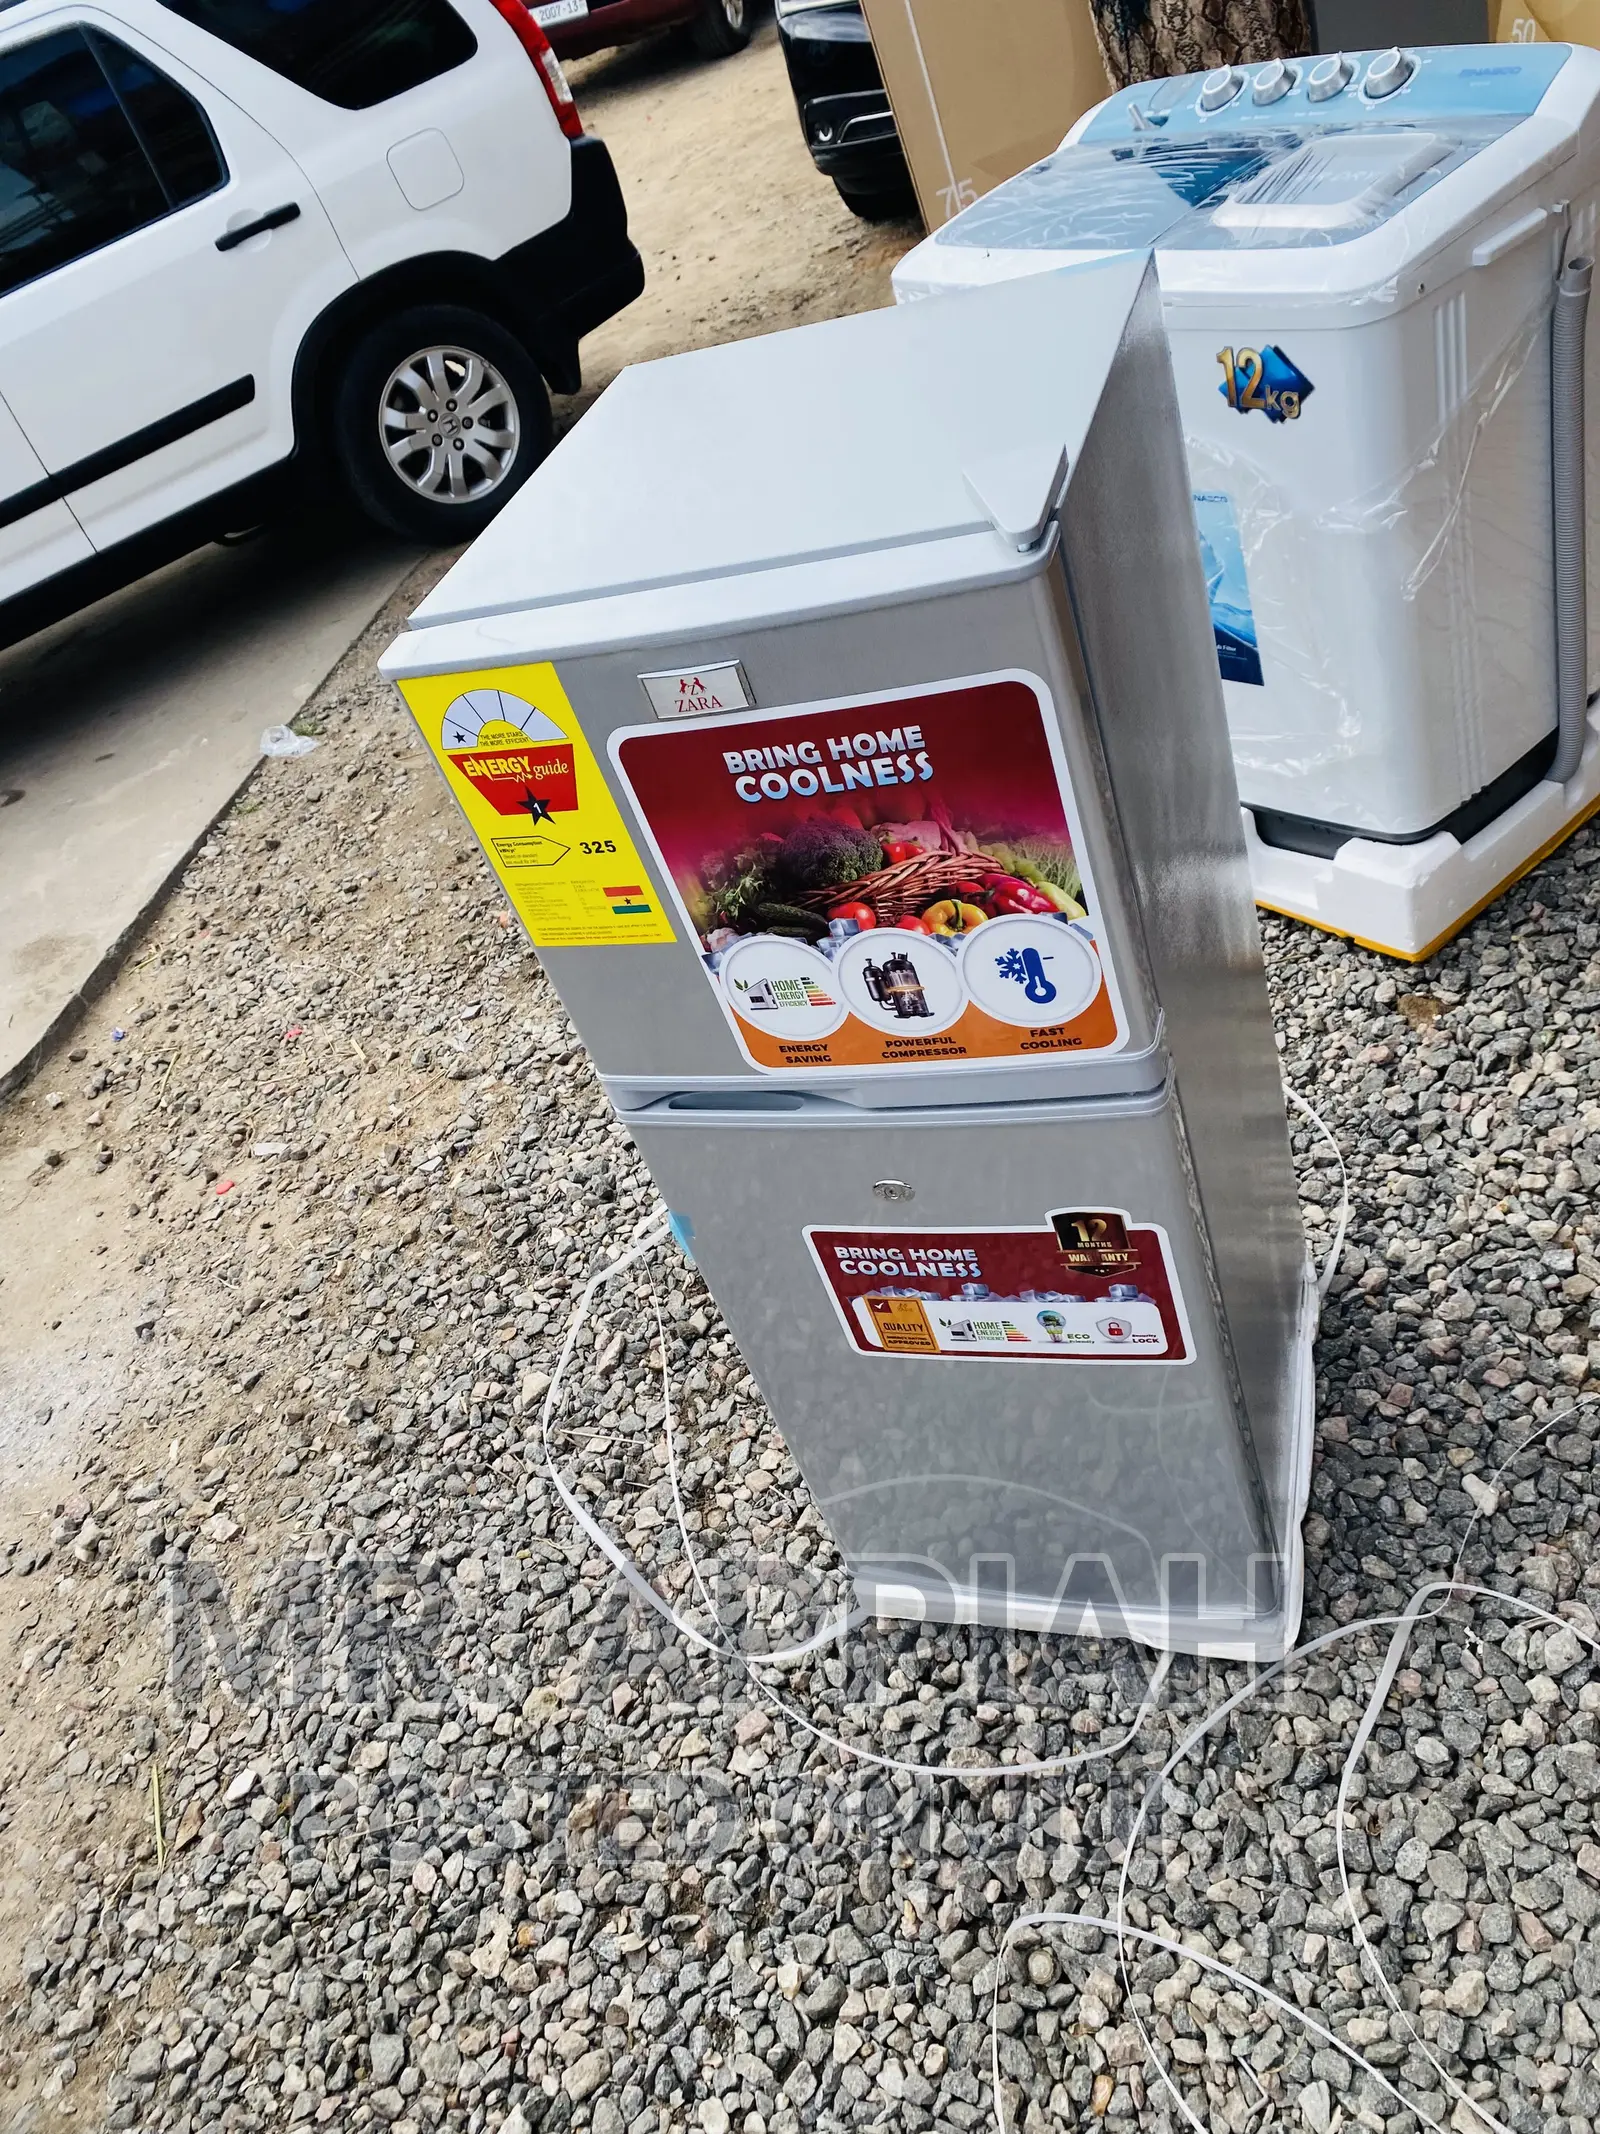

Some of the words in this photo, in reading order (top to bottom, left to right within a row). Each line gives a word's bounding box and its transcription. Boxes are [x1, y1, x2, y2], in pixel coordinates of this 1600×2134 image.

[539, 1, 579, 21] 2007-13
[1511, 18, 1536, 43] 50
[674, 694, 723, 713] ZARA
[506, 737, 529, 745] EFFICIENT
[723, 741, 823, 775] BRING
[826, 725, 926, 761] HOME
[462, 755, 531, 781] ENERGY
[533, 758, 570, 780] guide
[735, 751, 934, 803] COOLNESS
[532, 802, 543, 815] 1
[579, 840, 617, 854] 325
[771, 979, 803, 992] HOME
[775, 991, 805, 1001] ENERGY
[1030, 1027, 1065, 1038] FAST
[779, 1044, 829, 1053] ENERGY
[885, 1037, 957, 1049] POWERFUL
[1020, 1037, 1083, 1050] COOLING
[785, 1054, 832, 1064] SAVING
[881, 1047, 967, 1059] COMPRESSOR
[1071, 1218, 1108, 1242] 12
[833, 1246, 905, 1261] BRING
[908, 1248, 978, 1261] HOME
[1068, 1253, 1128, 1263] WAANTY
[839, 1260, 982, 1278] COOLNESS
[883, 1322, 923, 1333] QUALITY
[973, 1321, 1001, 1330] HOME
